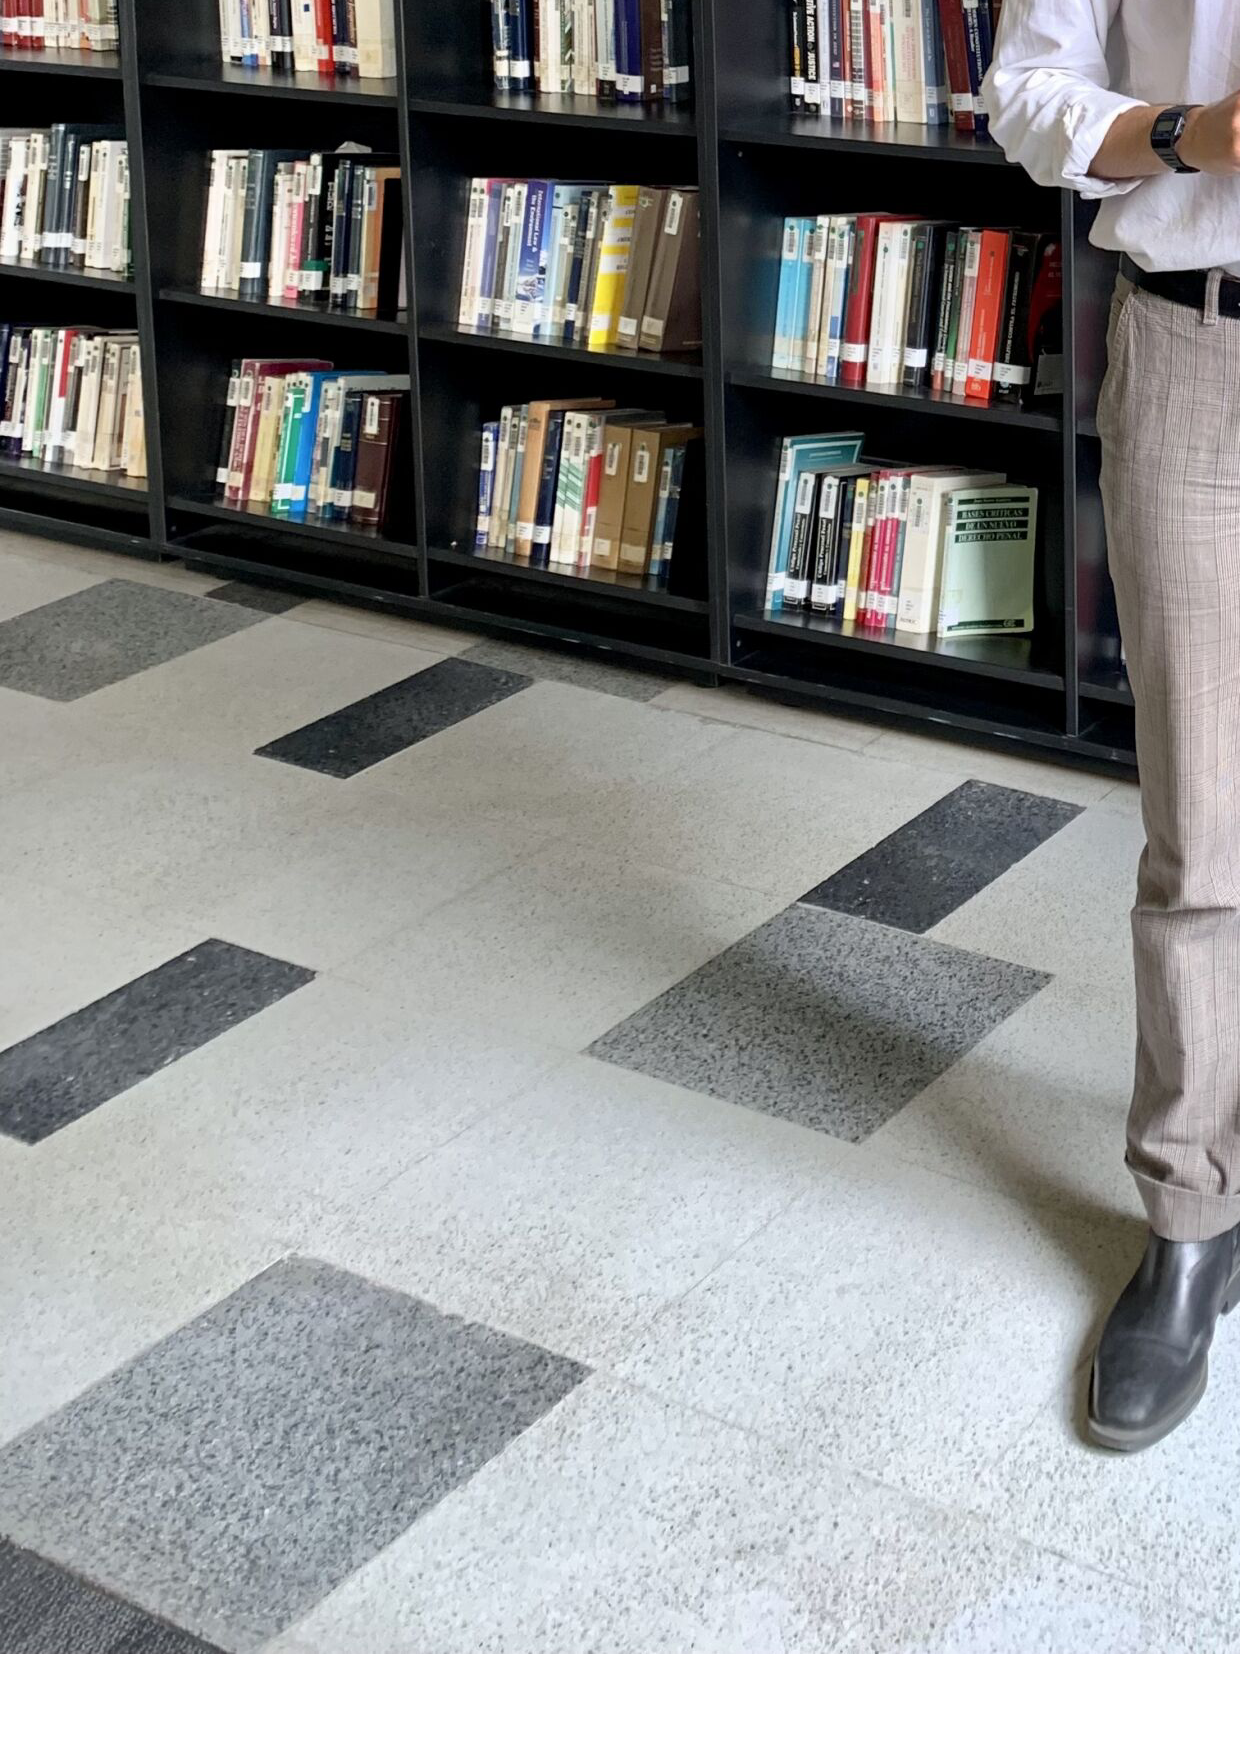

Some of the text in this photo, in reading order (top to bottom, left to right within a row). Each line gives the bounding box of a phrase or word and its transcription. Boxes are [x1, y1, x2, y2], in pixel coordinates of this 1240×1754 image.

[806, 16, 815, 42] ACTION
[807, 52, 816, 80] JUSTICE
[534, 190, 544, 231] International
[961, 507, 1024, 519] BASES CRÍTICAS
[965, 522, 976, 530] DE
[989, 520, 1017, 529] NUEVO
[958, 531, 1023, 542] DERECHO PENAL
